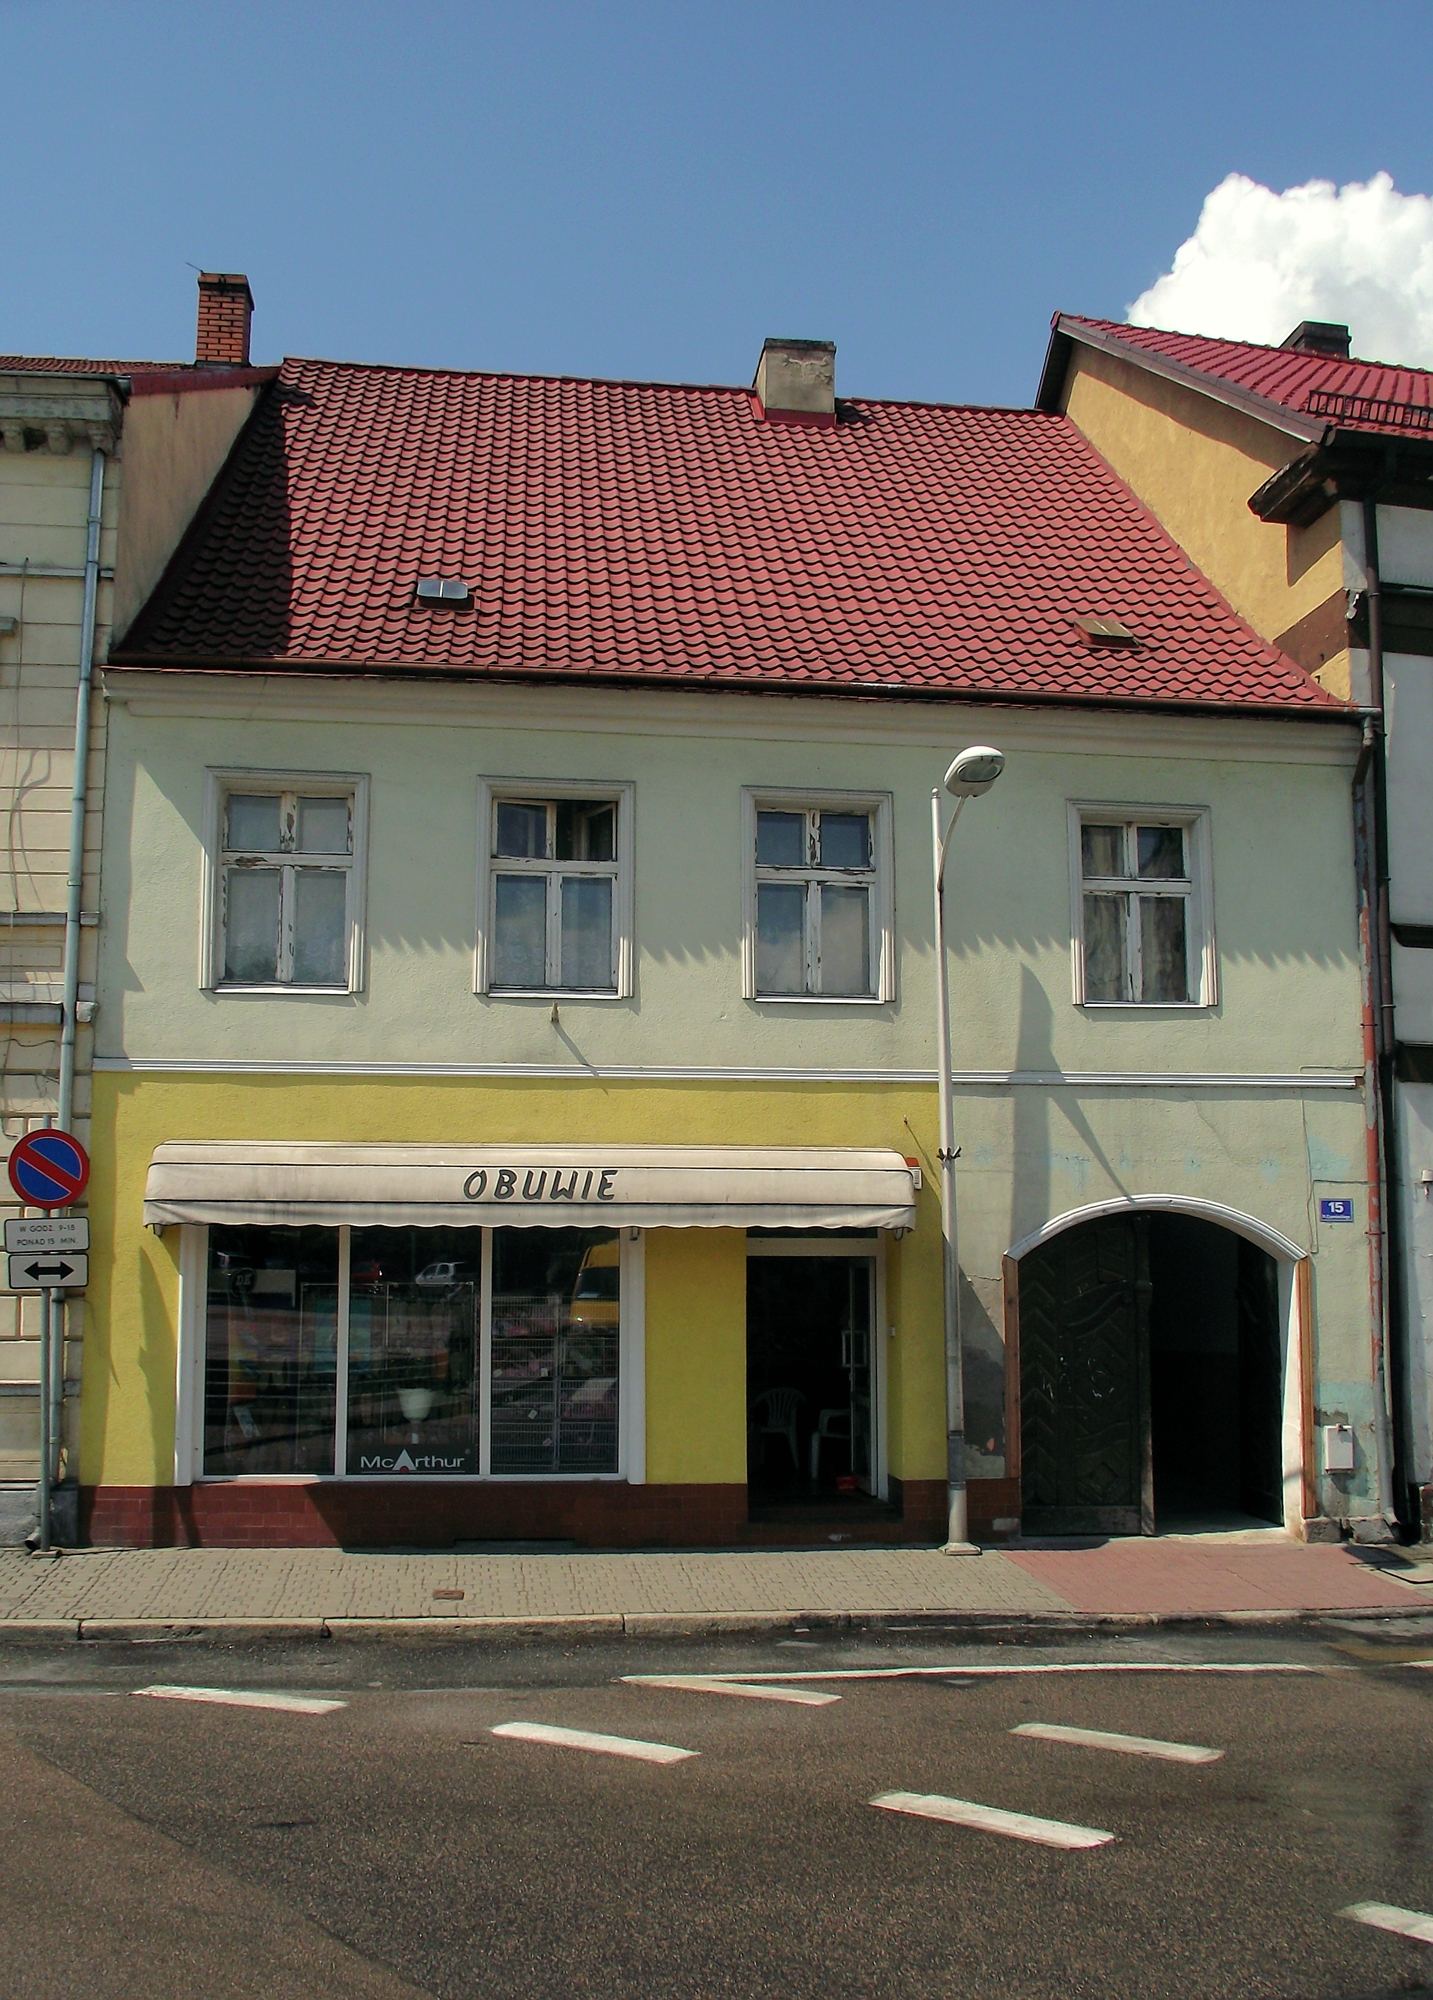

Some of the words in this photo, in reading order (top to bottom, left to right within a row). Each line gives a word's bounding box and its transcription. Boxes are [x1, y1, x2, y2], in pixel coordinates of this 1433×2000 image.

[463, 1169, 618, 1200] OBUWIE
[1328, 1201, 1344, 1213] 15
[16, 1238, 46, 1246] PONAD
[360, 1448, 465, 1471] McArthur
